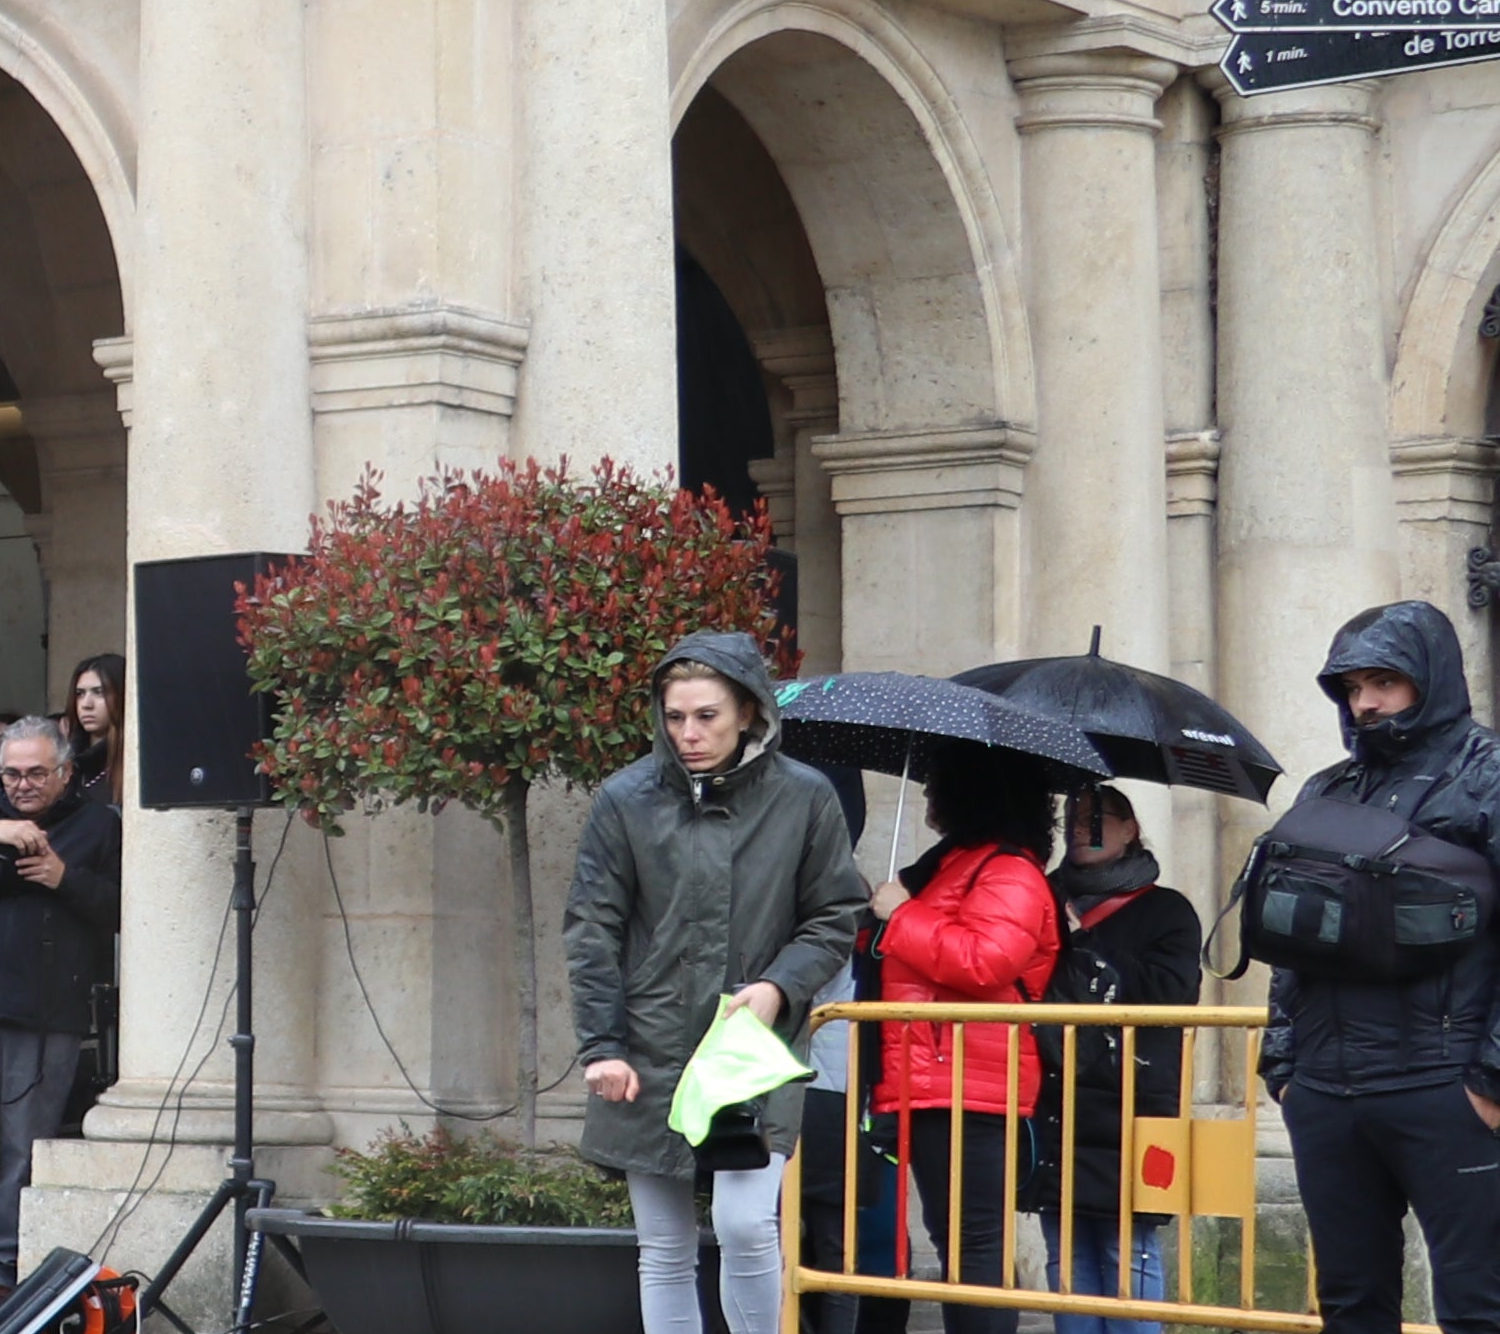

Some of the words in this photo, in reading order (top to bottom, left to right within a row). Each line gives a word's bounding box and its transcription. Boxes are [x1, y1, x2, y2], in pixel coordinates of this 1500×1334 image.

[1260, 0, 1271, 14] 5
[1273, 0, 1307, 13] min.
[1404, 34, 1435, 56] de
[1266, 50, 1274, 63] 1
[1277, 46, 1309, 61] min.
